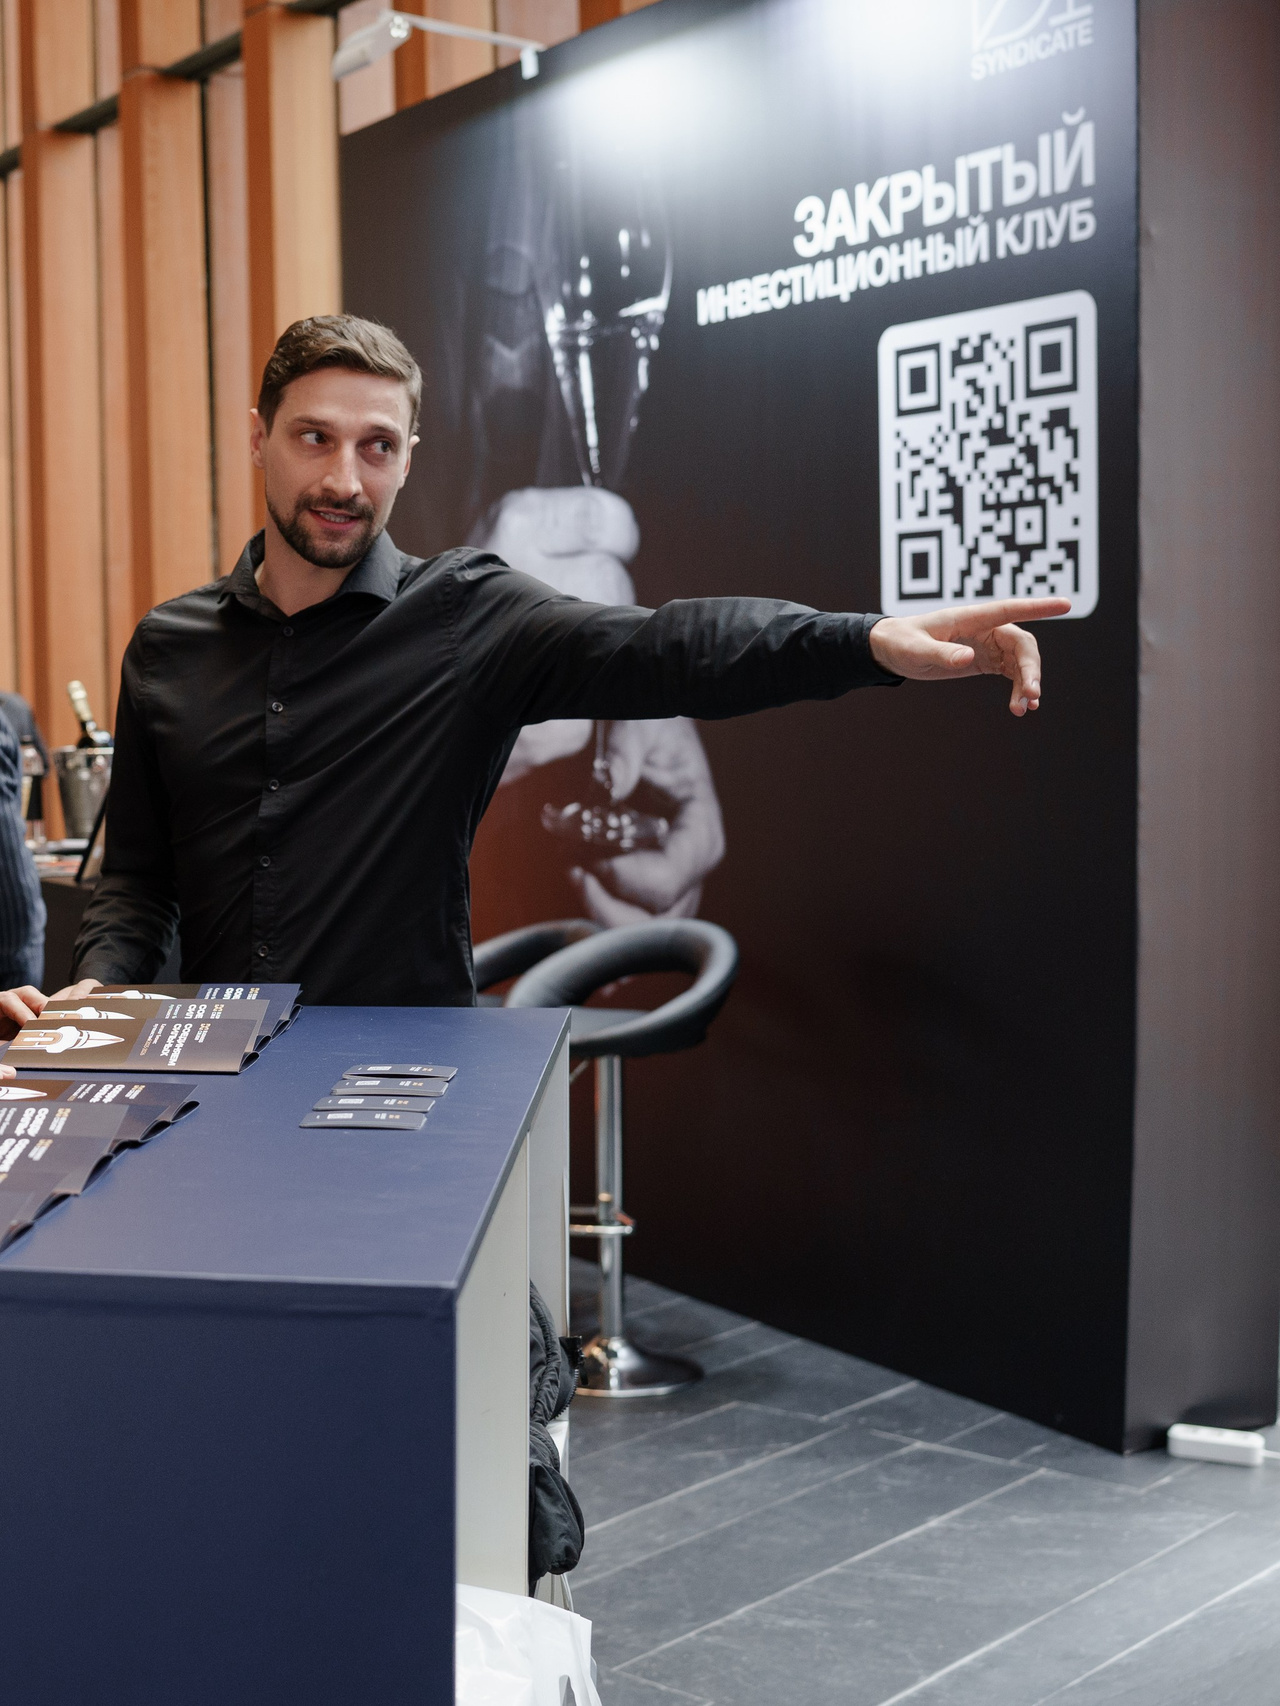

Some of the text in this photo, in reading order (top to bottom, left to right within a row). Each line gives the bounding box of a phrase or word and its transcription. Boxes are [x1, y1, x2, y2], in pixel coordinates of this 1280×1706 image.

[971, 18, 1094, 80] SYNDICATE
[793, 107, 1095, 257] ЗАКРЫТЫЙ
[697, 197, 1097, 326] ИНВЕСТИЦИОННЫЙ КЛУБ
